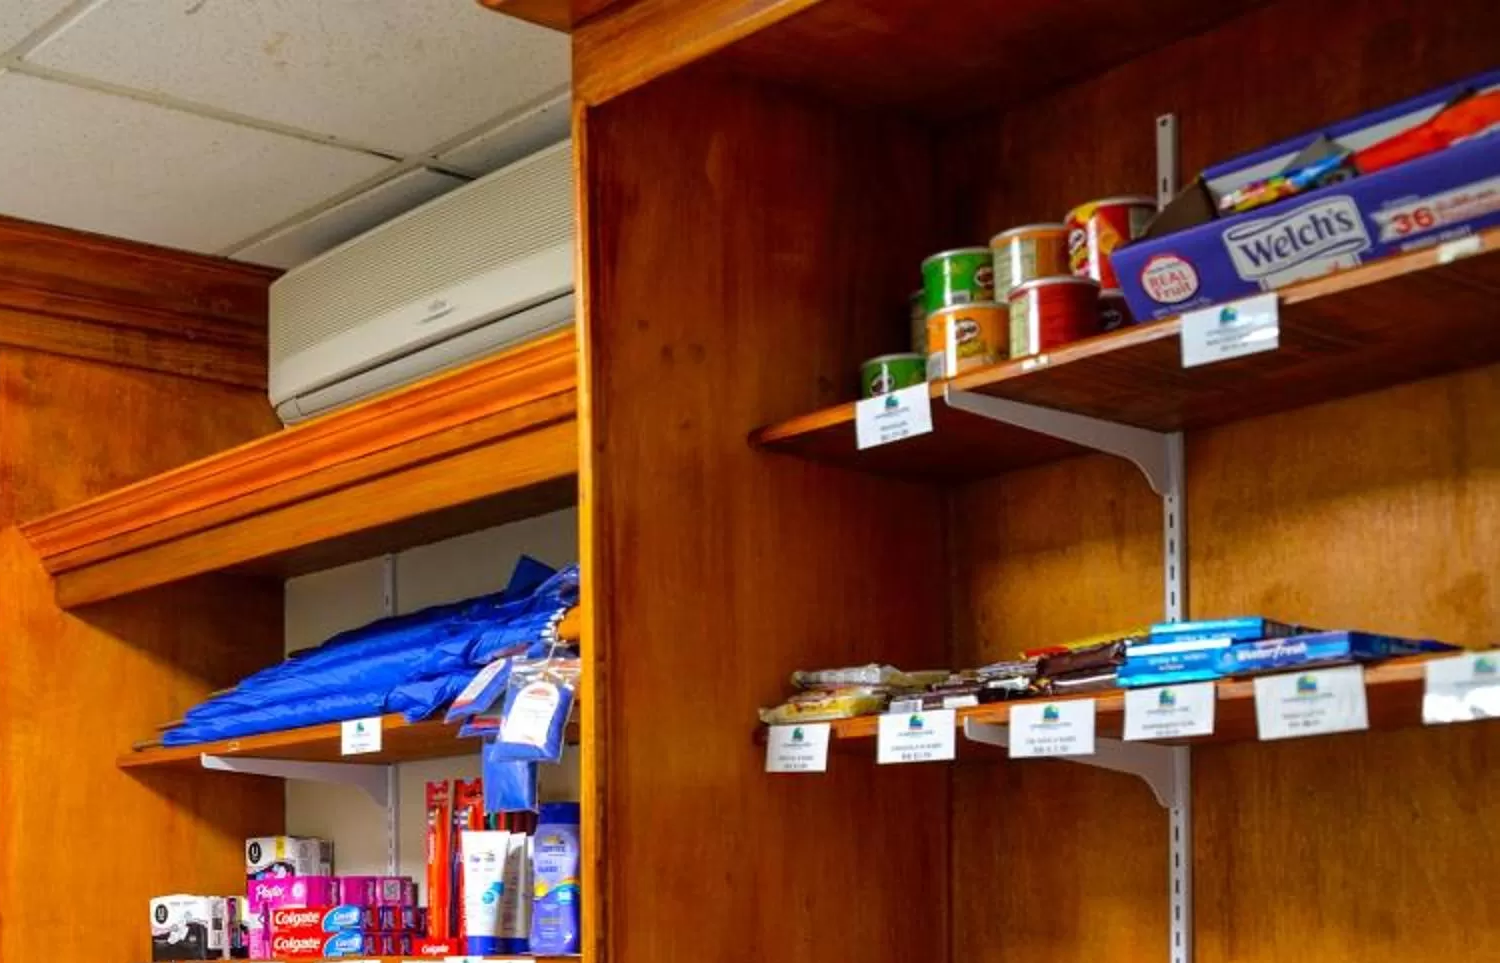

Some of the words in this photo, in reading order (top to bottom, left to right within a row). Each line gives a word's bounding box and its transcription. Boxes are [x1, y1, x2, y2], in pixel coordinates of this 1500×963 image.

[1392, 206, 1436, 235] 36
[1239, 206, 1355, 269] Welch's
[275, 911, 321, 927] Colgate
[274, 937, 322, 954] Colgate
